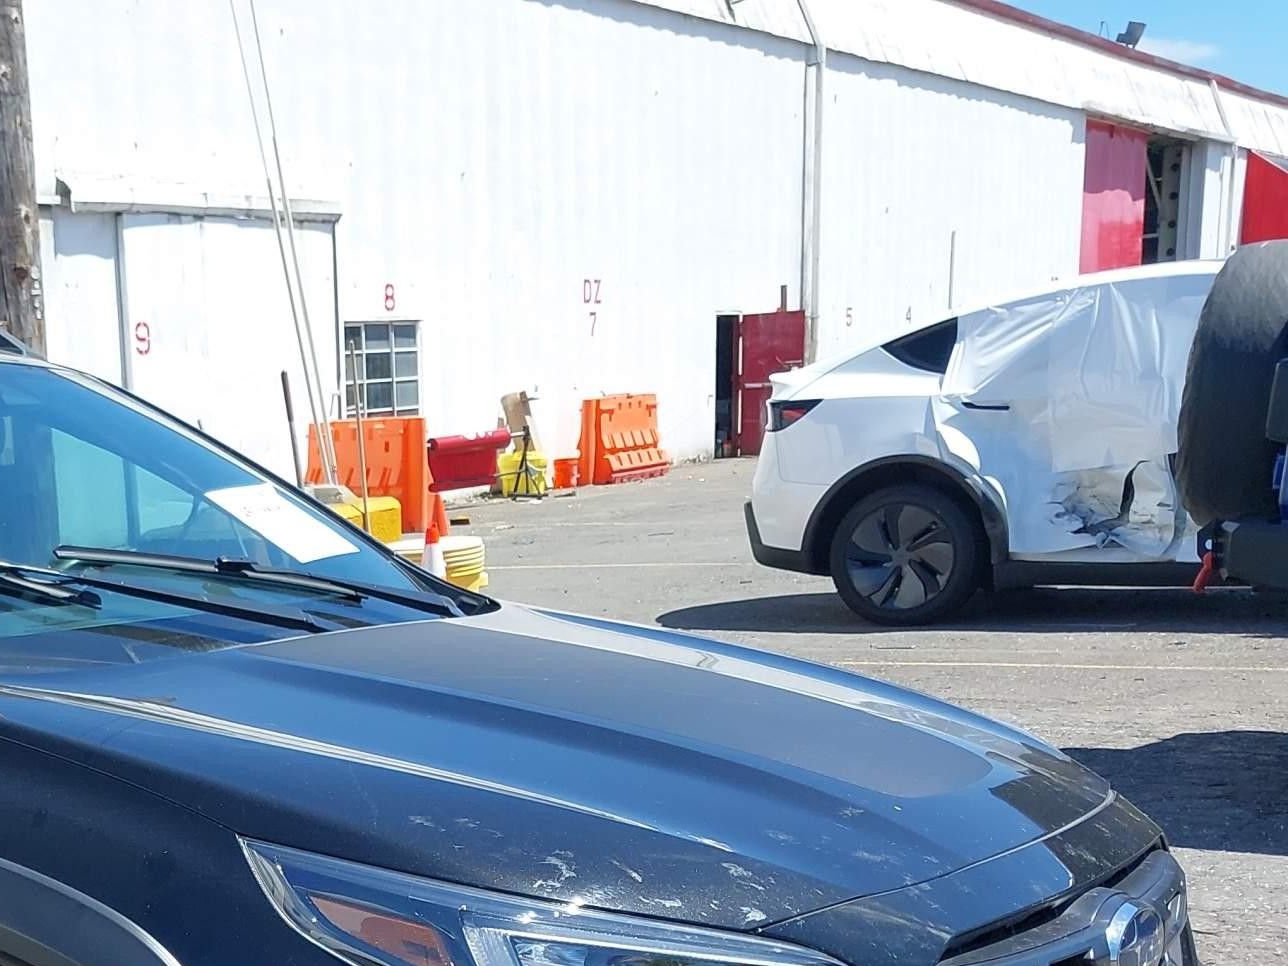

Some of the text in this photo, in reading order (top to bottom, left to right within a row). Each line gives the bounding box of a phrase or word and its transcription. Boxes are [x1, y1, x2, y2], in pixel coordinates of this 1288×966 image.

[384, 283, 396, 311] 8
[583, 278, 602, 304] DZ
[589, 311, 597, 336] 7
[845, 307, 854, 327] 5
[905, 306, 912, 324] 4
[135, 321, 151, 355] 9
